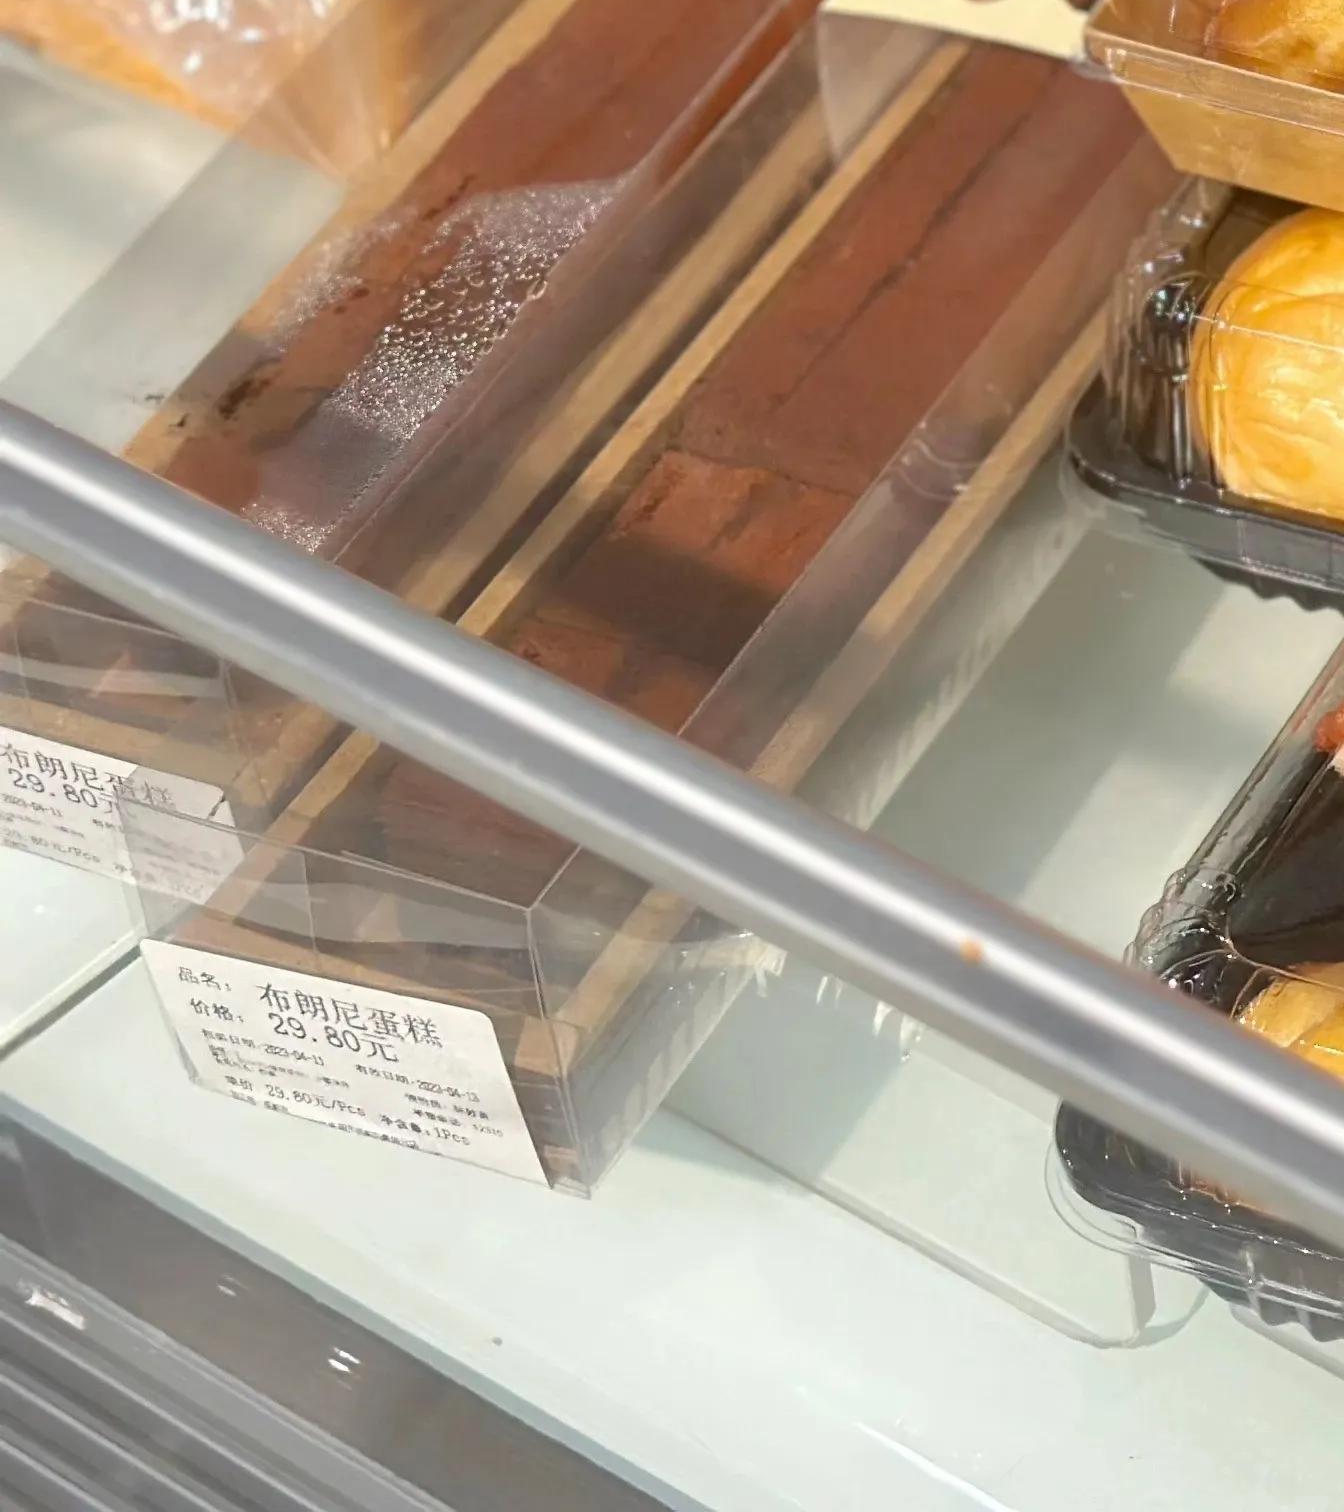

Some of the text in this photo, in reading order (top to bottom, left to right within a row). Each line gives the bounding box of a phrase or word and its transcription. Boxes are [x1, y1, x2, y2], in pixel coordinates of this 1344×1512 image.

[256, 982, 443, 1049] 布朗尼蛋糕
[268, 1011, 399, 1063] 29.80元
